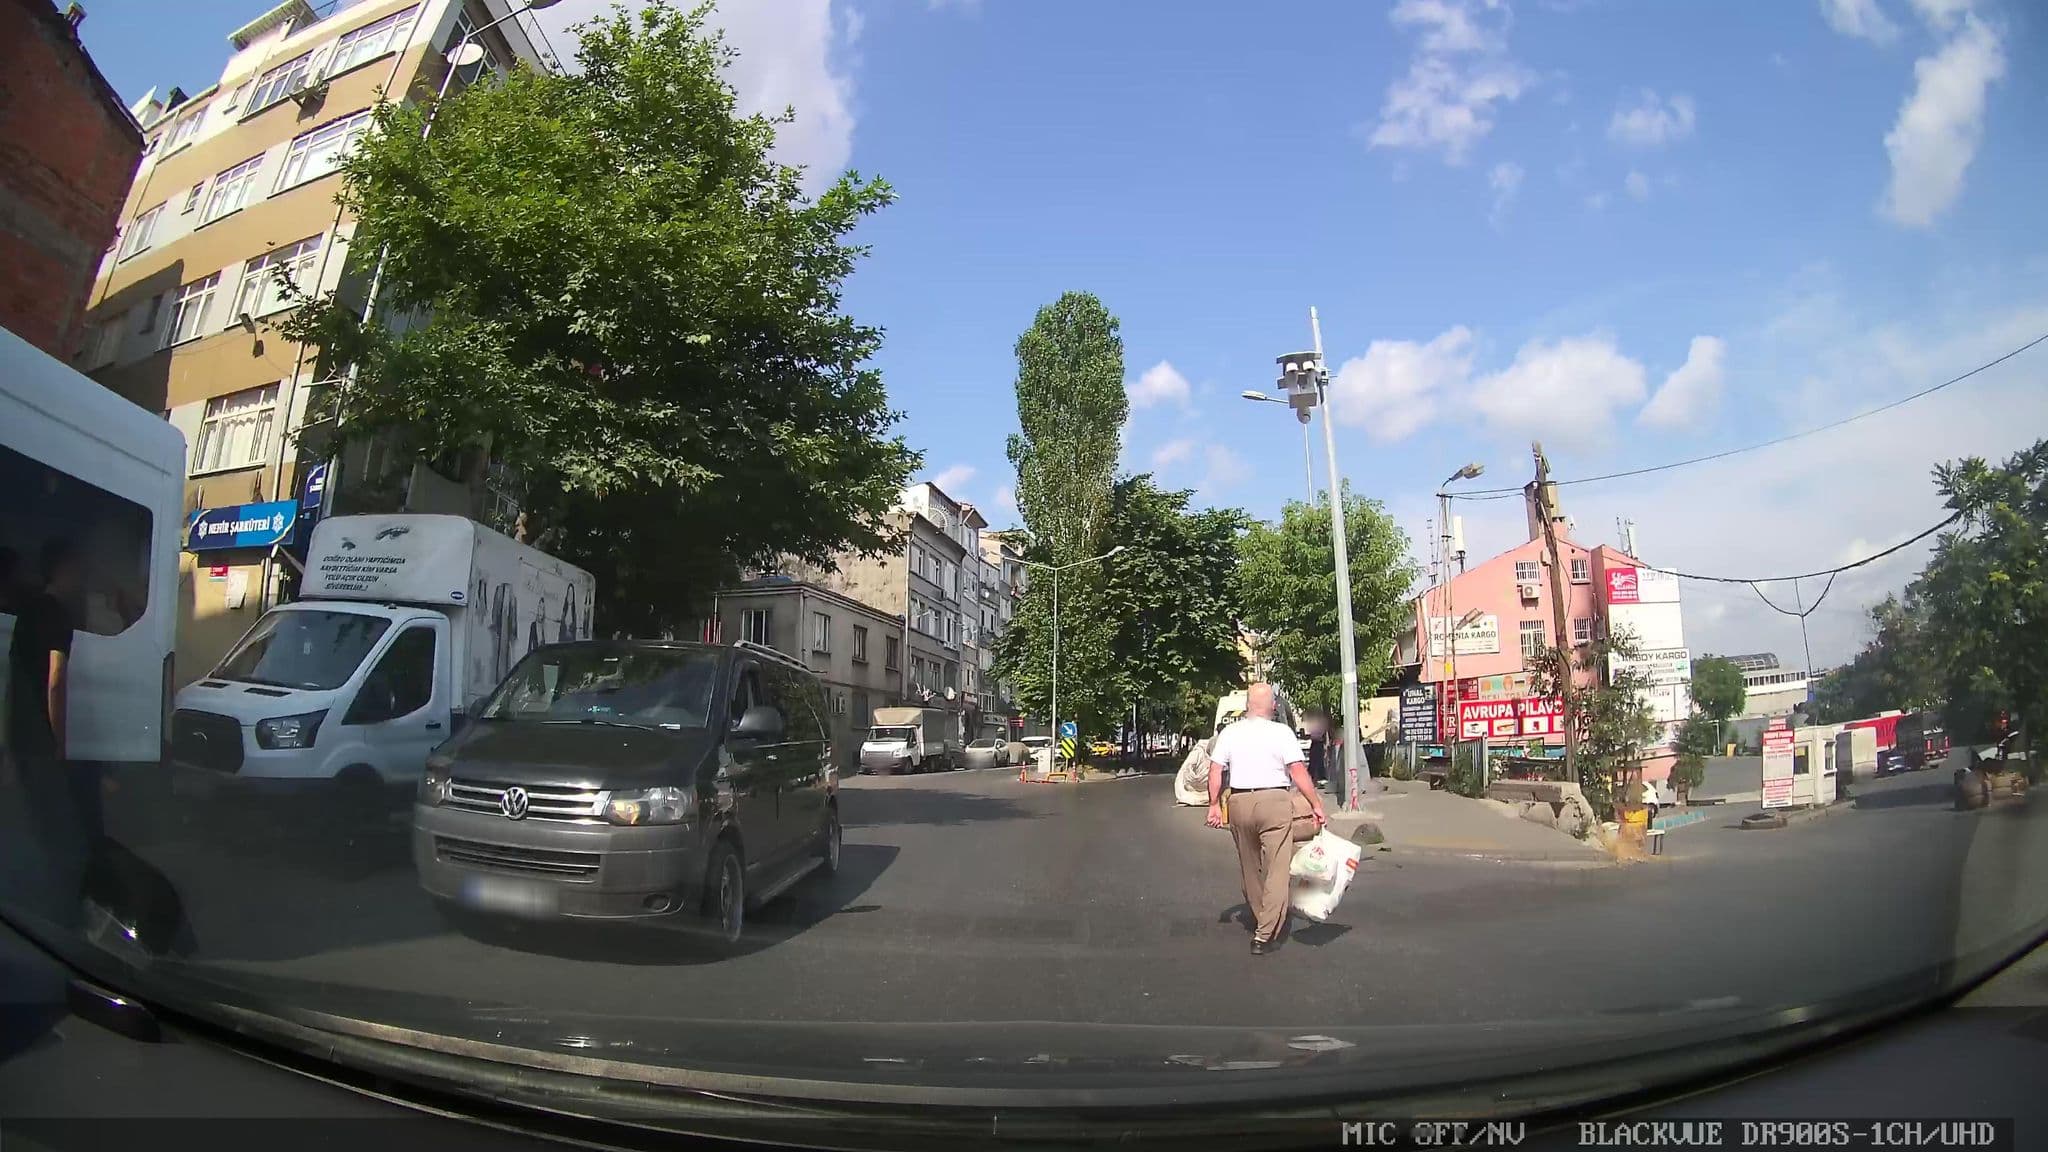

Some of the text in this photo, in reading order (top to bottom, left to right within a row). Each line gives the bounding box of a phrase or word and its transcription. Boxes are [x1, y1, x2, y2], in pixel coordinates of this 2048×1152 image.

[1471, 630, 1497, 640] KARGO
[1655, 651, 1688, 661] KARGO
[1463, 704, 1514, 720] AVRUPA
